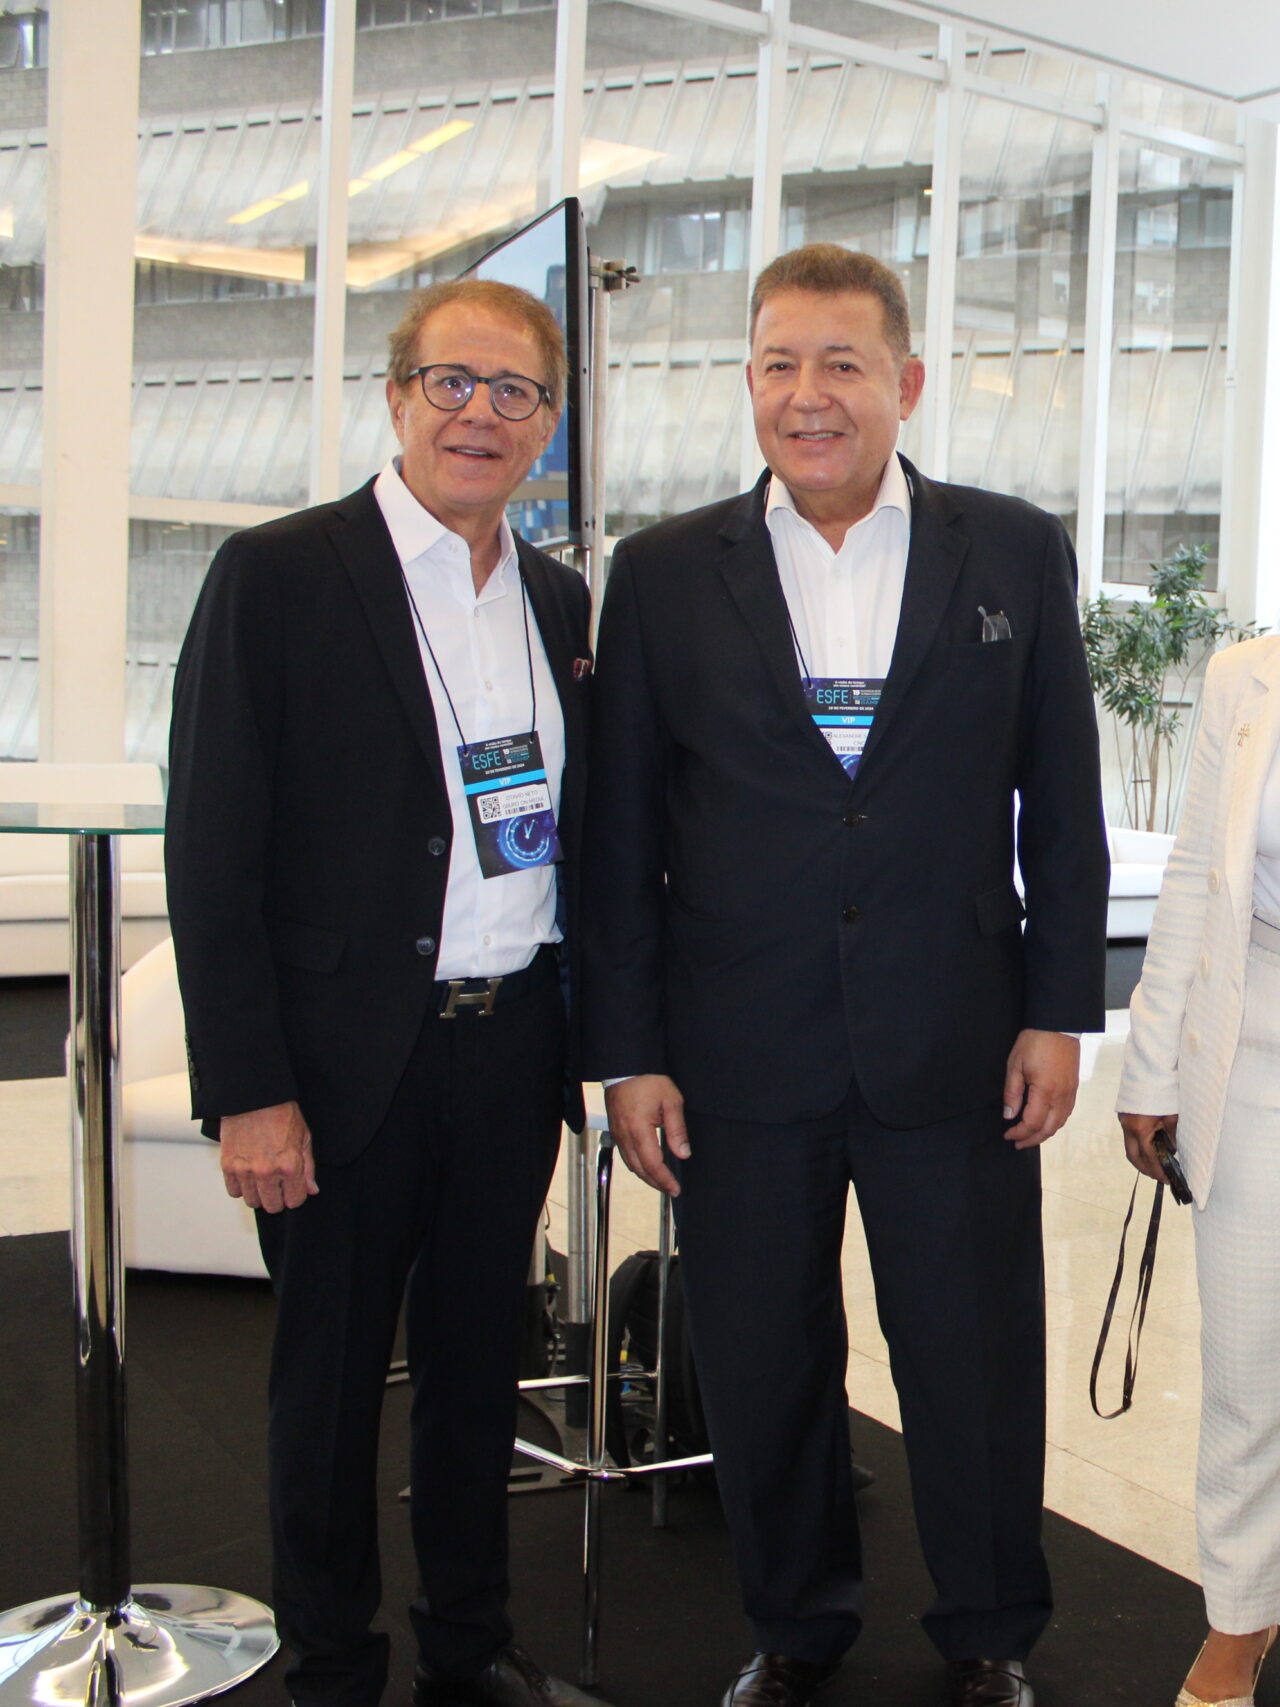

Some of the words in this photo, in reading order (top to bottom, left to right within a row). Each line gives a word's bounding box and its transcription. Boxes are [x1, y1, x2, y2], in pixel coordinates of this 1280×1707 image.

[816, 689, 849, 704] ESFE
[841, 716, 856, 724] VIP
[472, 750, 501, 770] ESFE
